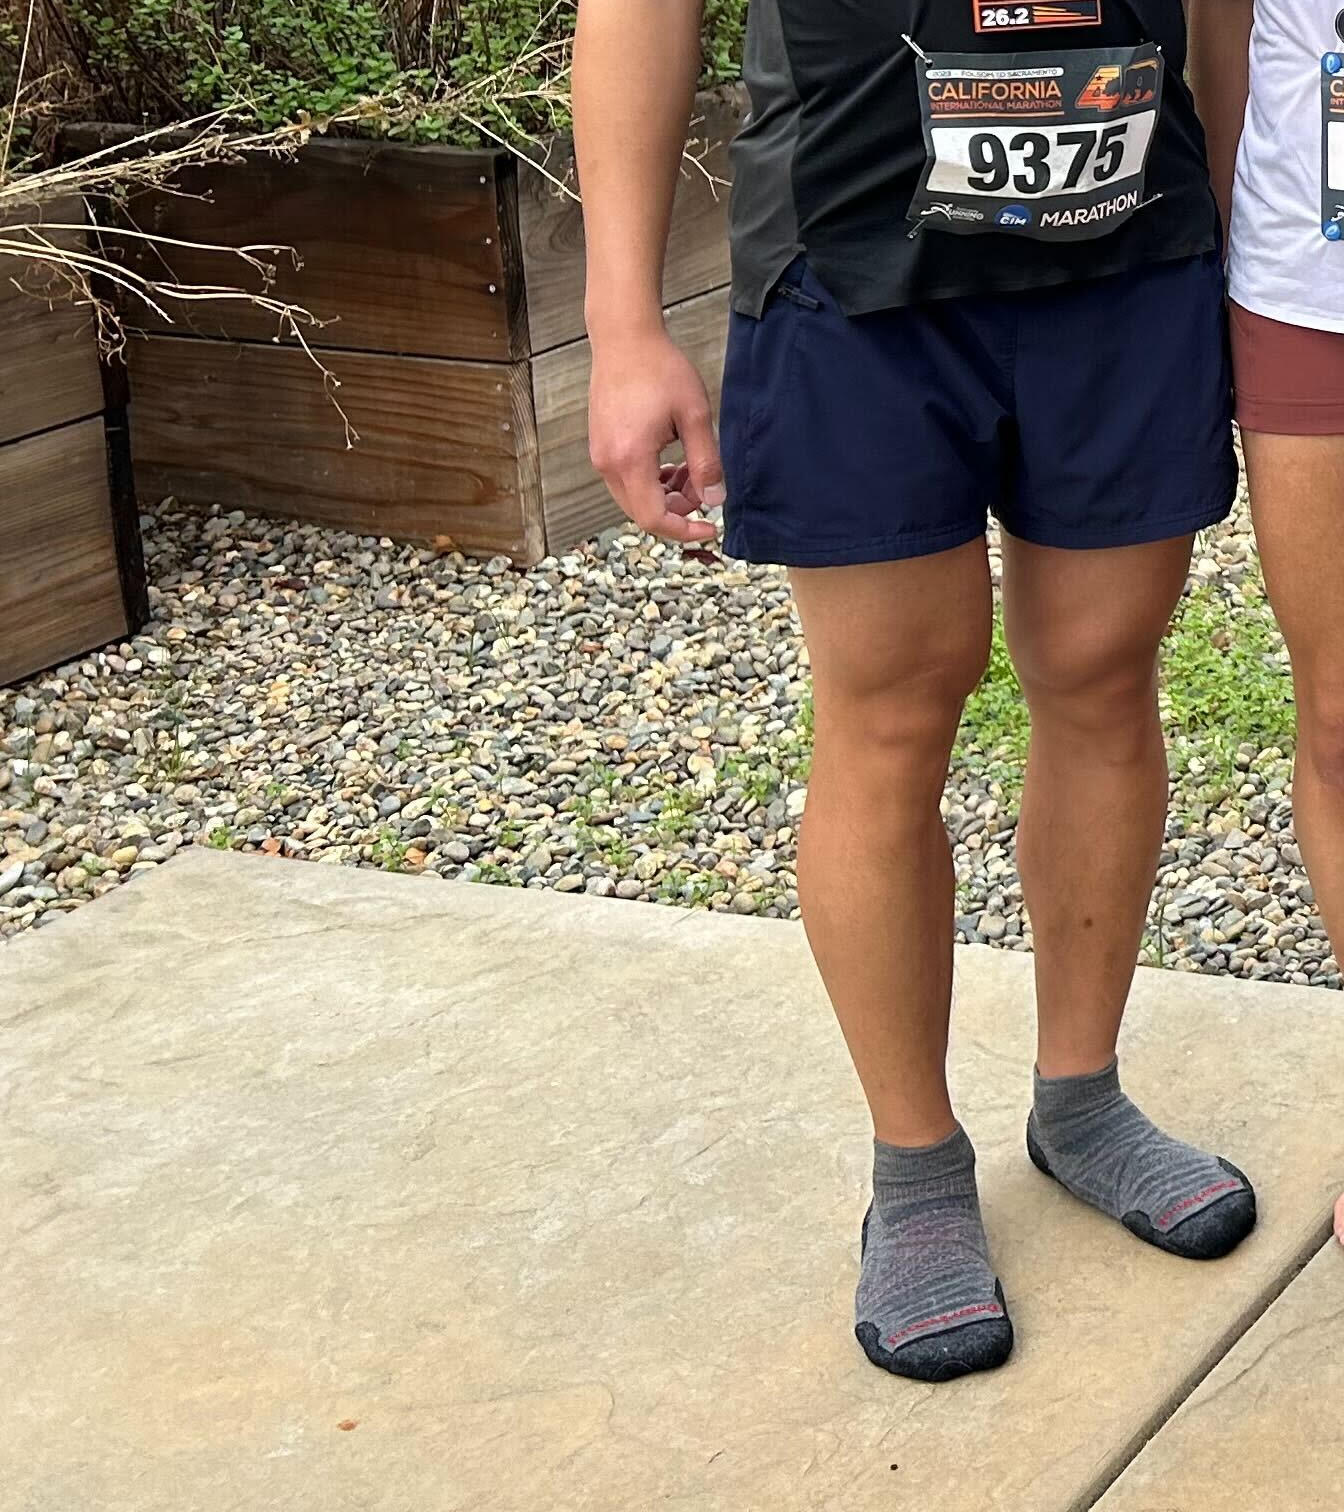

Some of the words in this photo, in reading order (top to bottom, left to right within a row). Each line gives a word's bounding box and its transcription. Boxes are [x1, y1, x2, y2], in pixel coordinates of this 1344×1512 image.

[981, 7, 1030, 27] 26.2
[928, 80, 1062, 100] CALIFORNIA
[967, 122, 1129, 194] 9375
[1040, 190, 1138, 228] MARATHON
